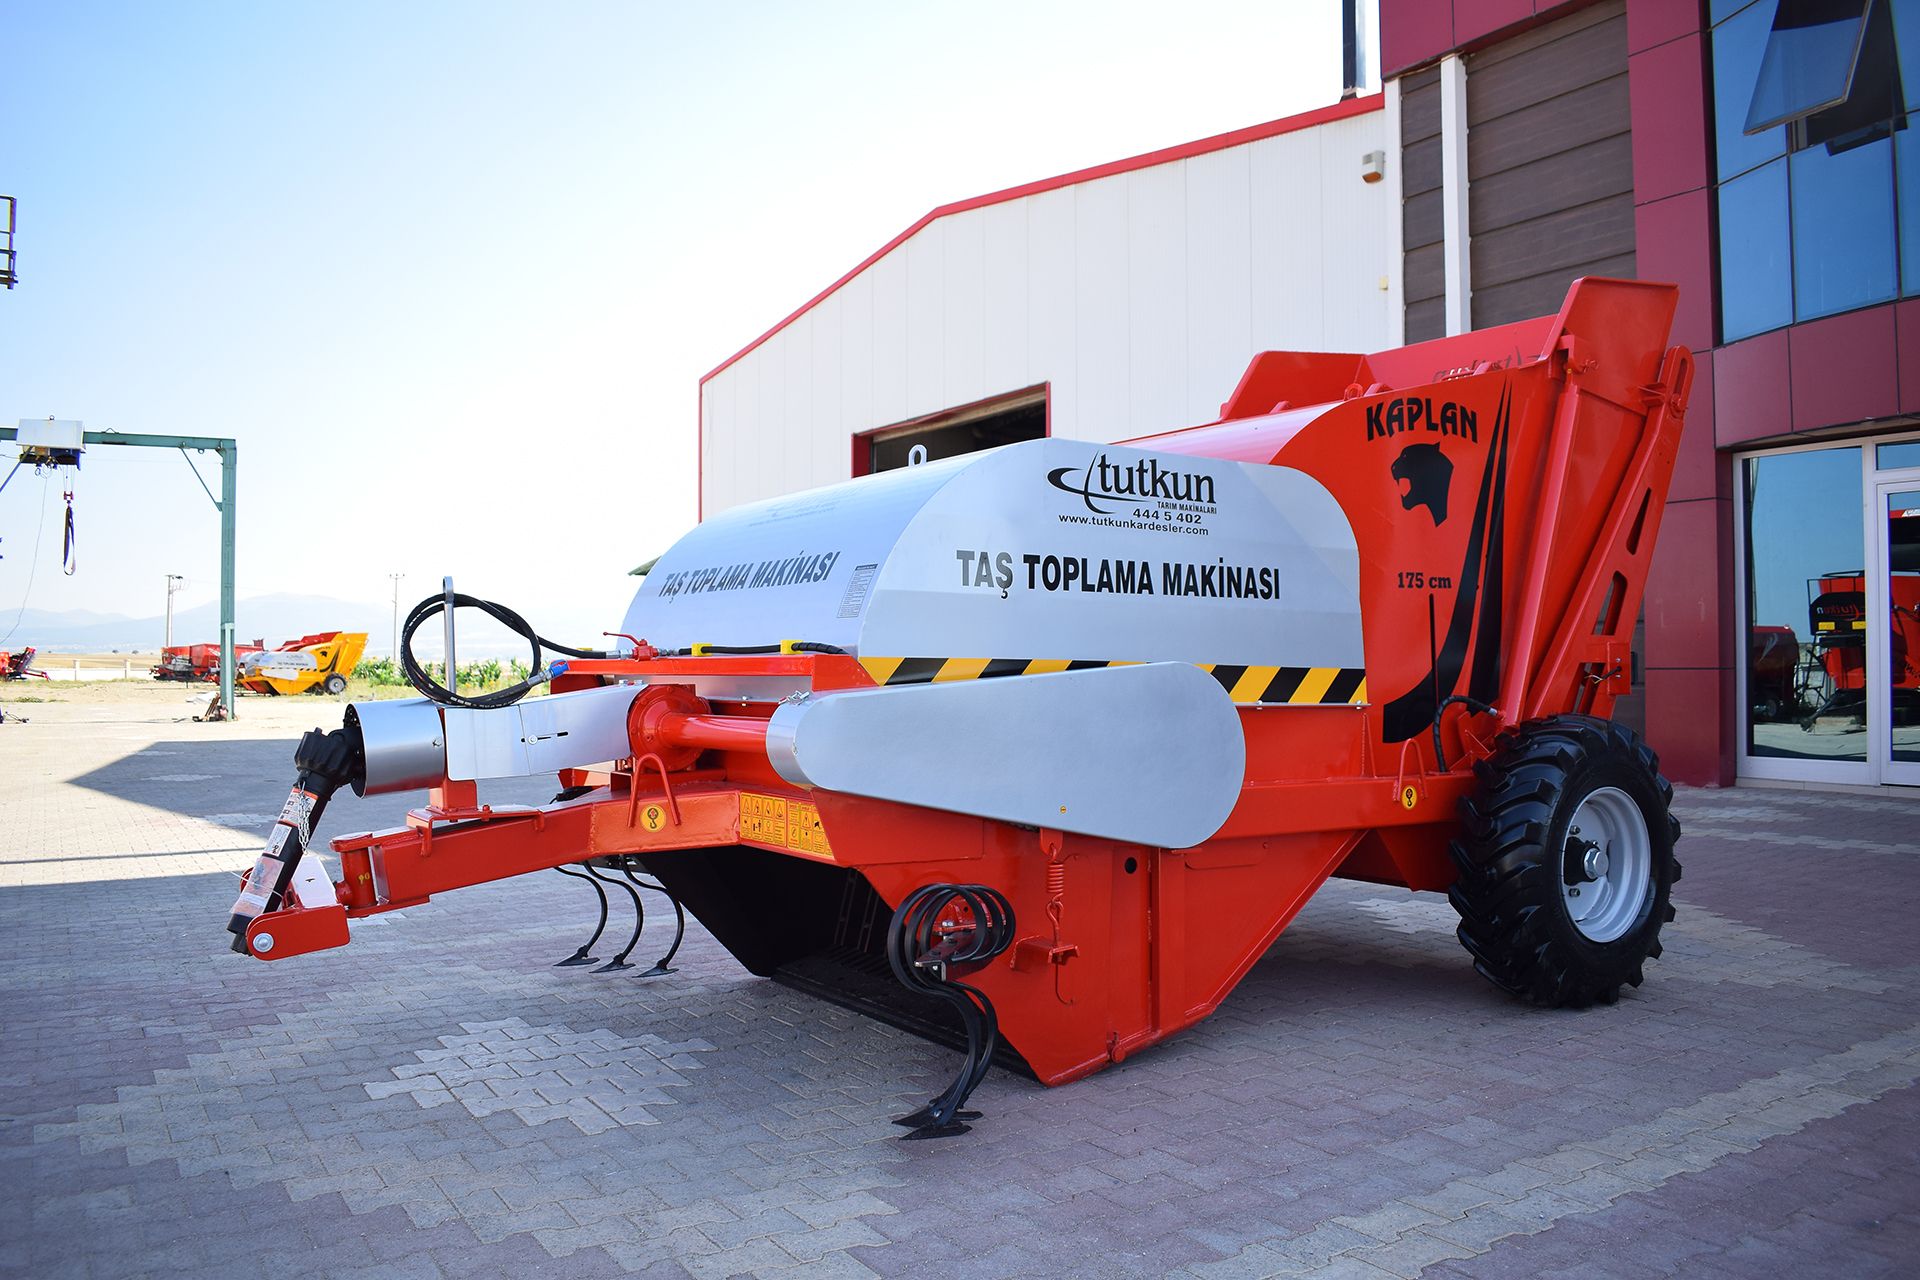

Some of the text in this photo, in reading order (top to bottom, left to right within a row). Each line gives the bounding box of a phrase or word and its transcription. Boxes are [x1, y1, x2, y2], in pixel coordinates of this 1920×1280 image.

[1366, 397, 1478, 444] KAPLAN
[1097, 453, 1217, 504] tutkun
[1133, 508, 1202, 525] 444 5 402
[1157, 501, 1178, 511] TARIM
[1058, 514, 1209, 536] www.tutkunkardesler.com
[658, 550, 841, 604] TAŞ TOPLAMA MAKİNASI
[956, 549, 1280, 600] TAŞ TOPLAMA MAKİNASI
[1397, 572, 1452, 589] 175 cm
